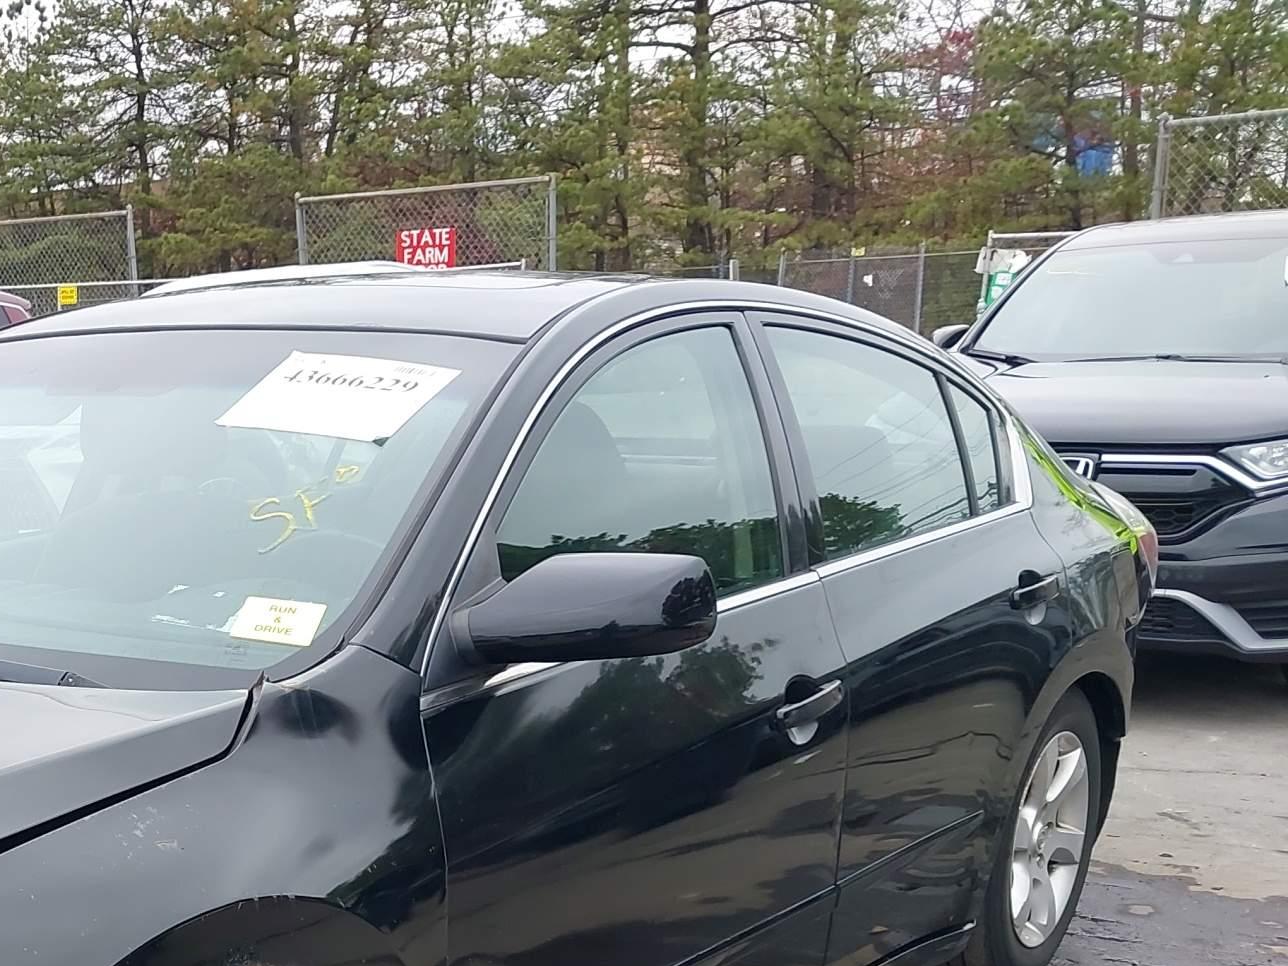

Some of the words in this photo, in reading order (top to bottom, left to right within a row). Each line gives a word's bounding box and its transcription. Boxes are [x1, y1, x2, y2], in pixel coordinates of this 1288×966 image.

[400, 228, 451, 247] STATE
[403, 246, 449, 265] FARM
[283, 368, 419, 393] 43666229
[268, 604, 298, 616] RUN
[273, 616, 282, 624] &
[253, 623, 294, 636] DRIVE
